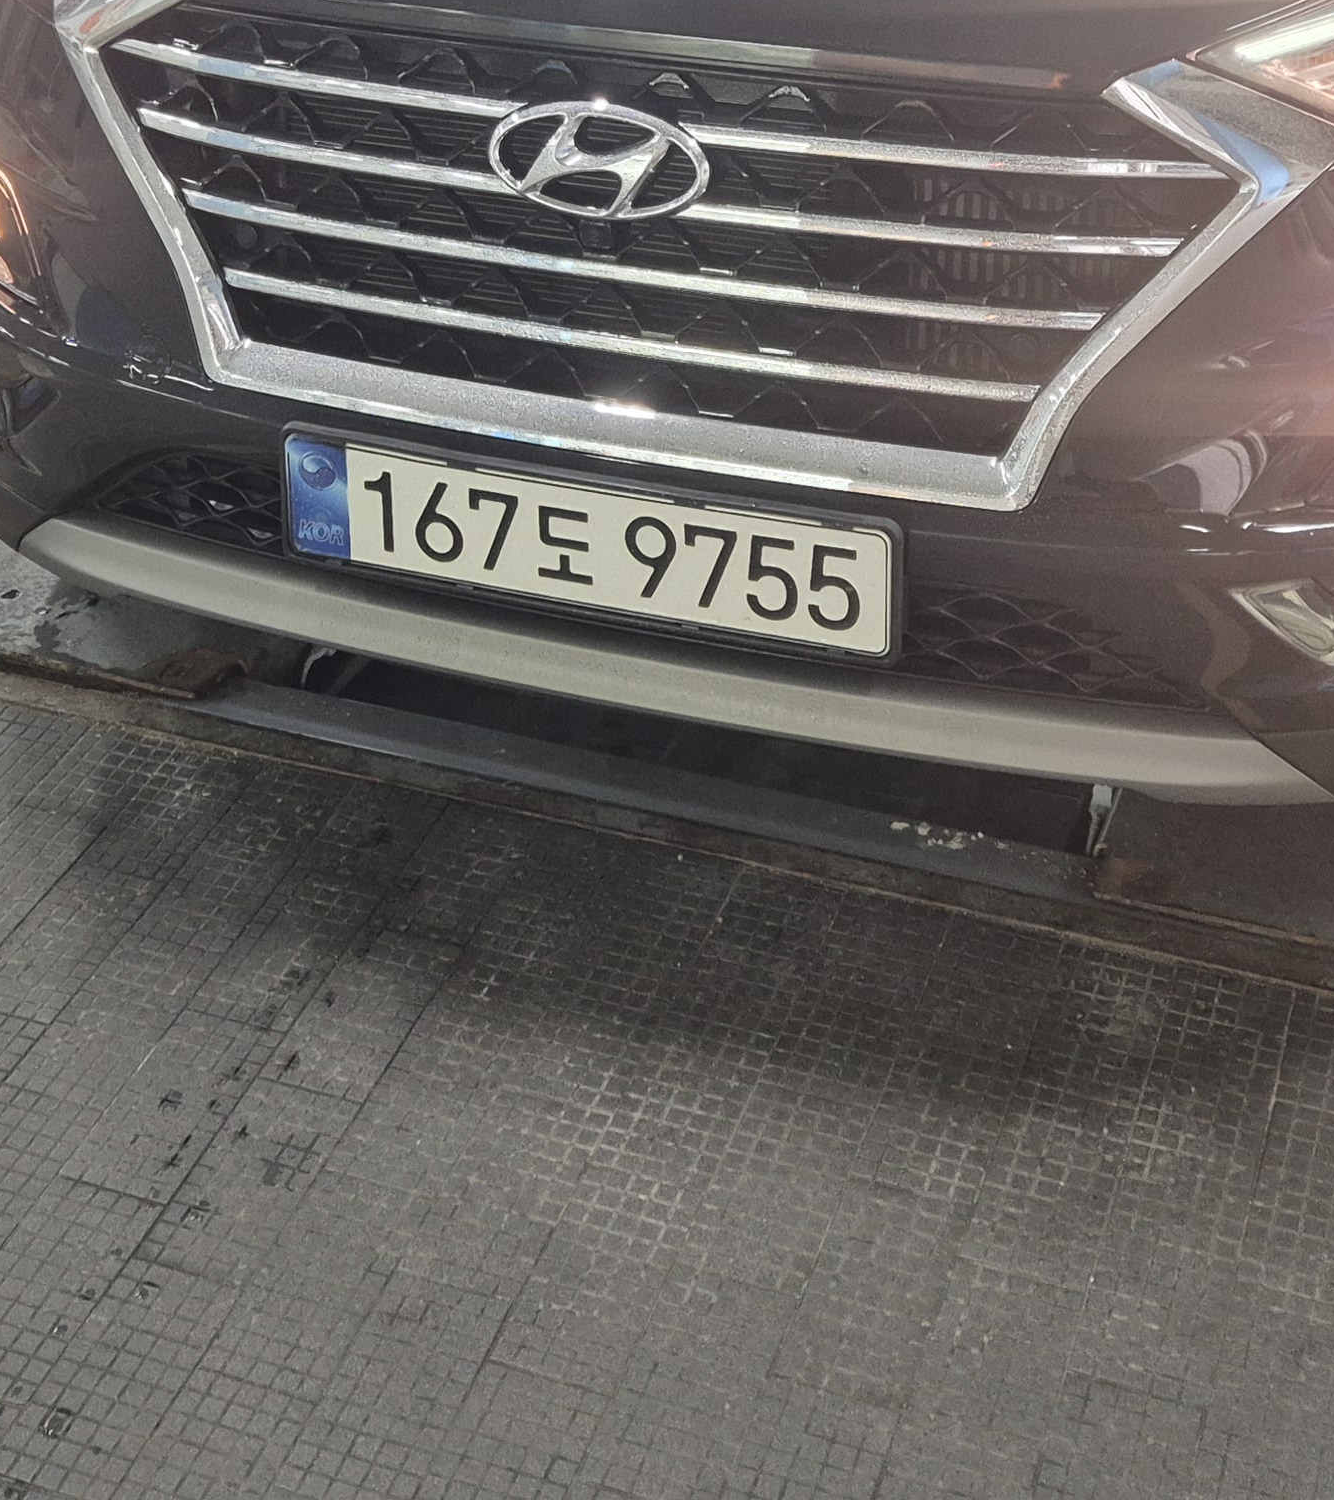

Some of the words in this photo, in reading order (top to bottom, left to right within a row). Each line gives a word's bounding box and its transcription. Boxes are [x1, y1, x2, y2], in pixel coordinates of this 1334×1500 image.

[298, 519, 344, 546] KOR
[363, 471, 593, 586] 167도
[624, 515, 860, 631] 9755
